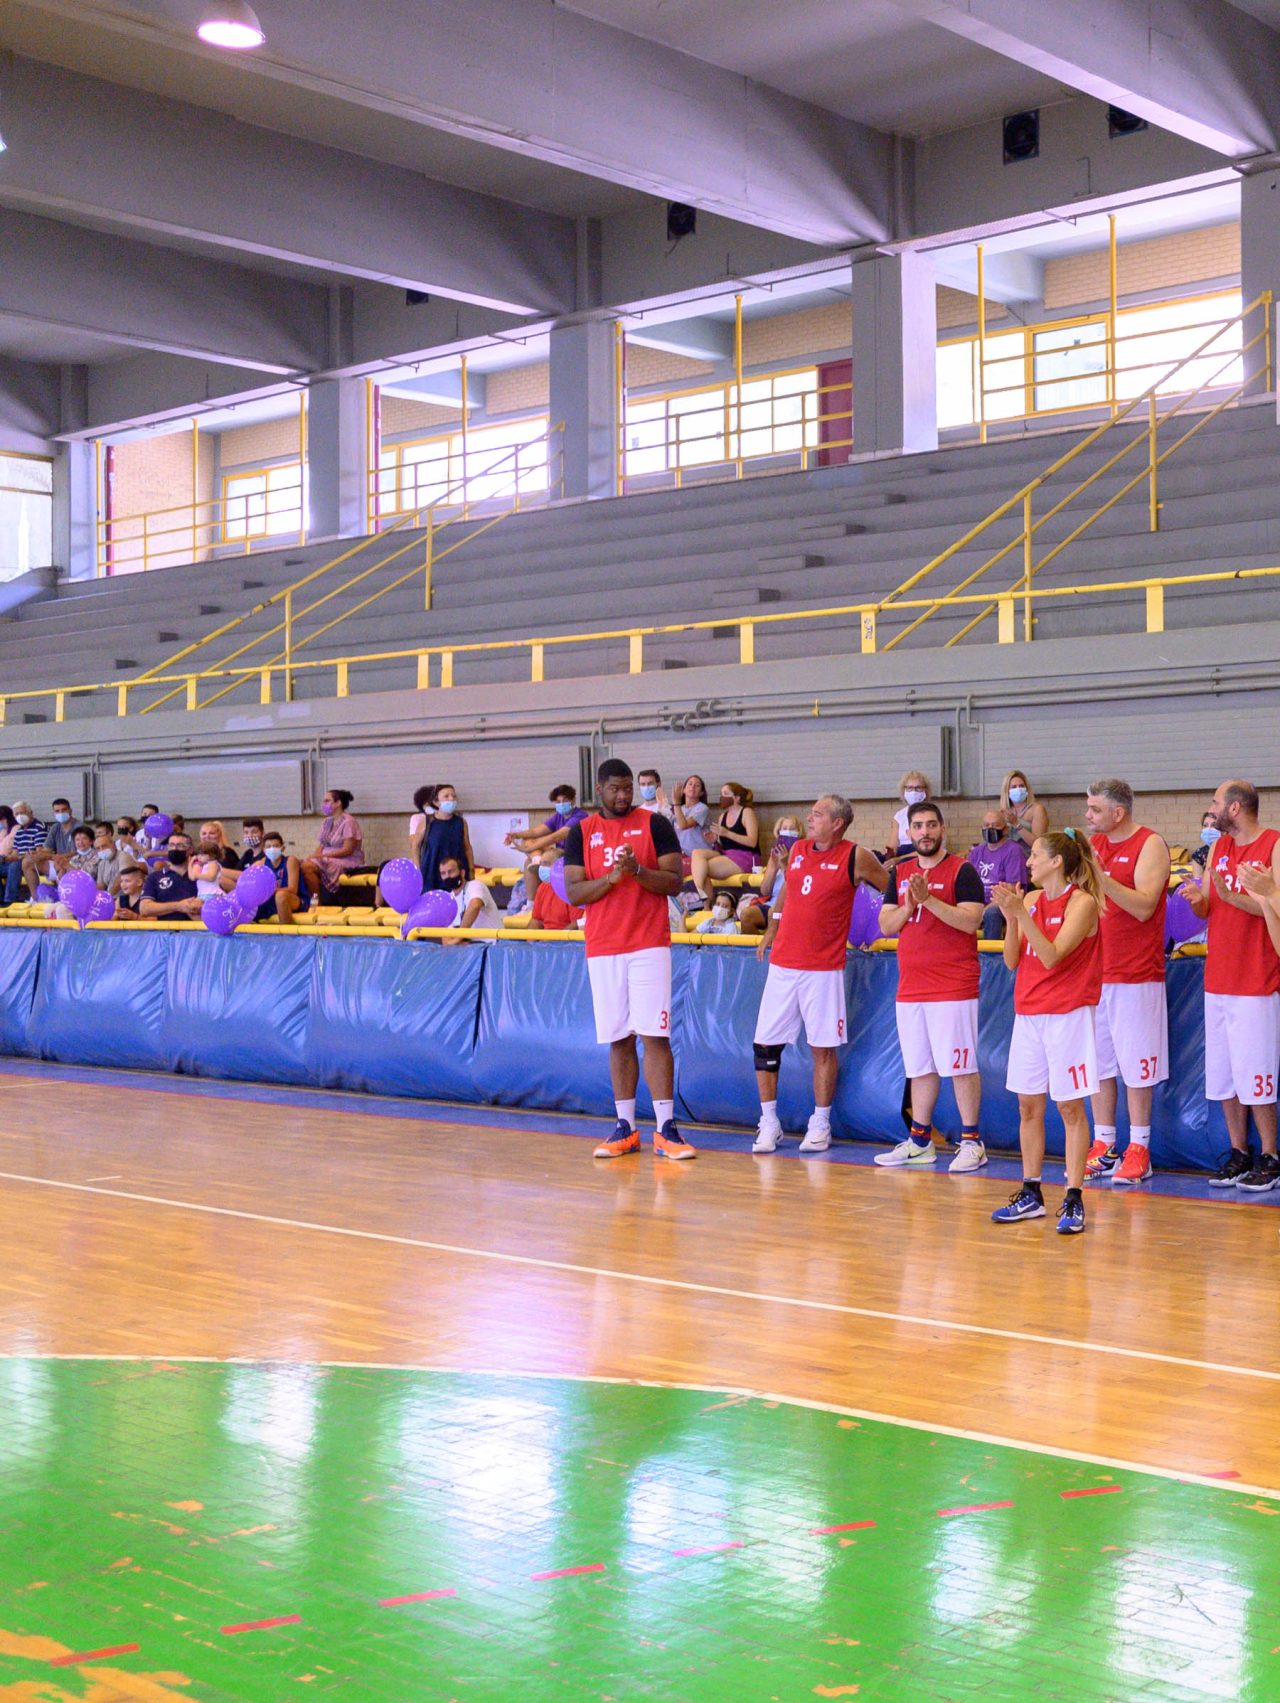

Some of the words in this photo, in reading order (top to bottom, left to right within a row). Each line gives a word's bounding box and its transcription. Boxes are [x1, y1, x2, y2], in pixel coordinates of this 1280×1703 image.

[801, 874, 813, 895] 8
[660, 1010, 668, 1030] 3
[952, 1048, 969, 1069] 21
[1140, 1056, 1158, 1080] 37
[1068, 1063, 1088, 1090] 11
[1253, 1074, 1274, 1097] 35
